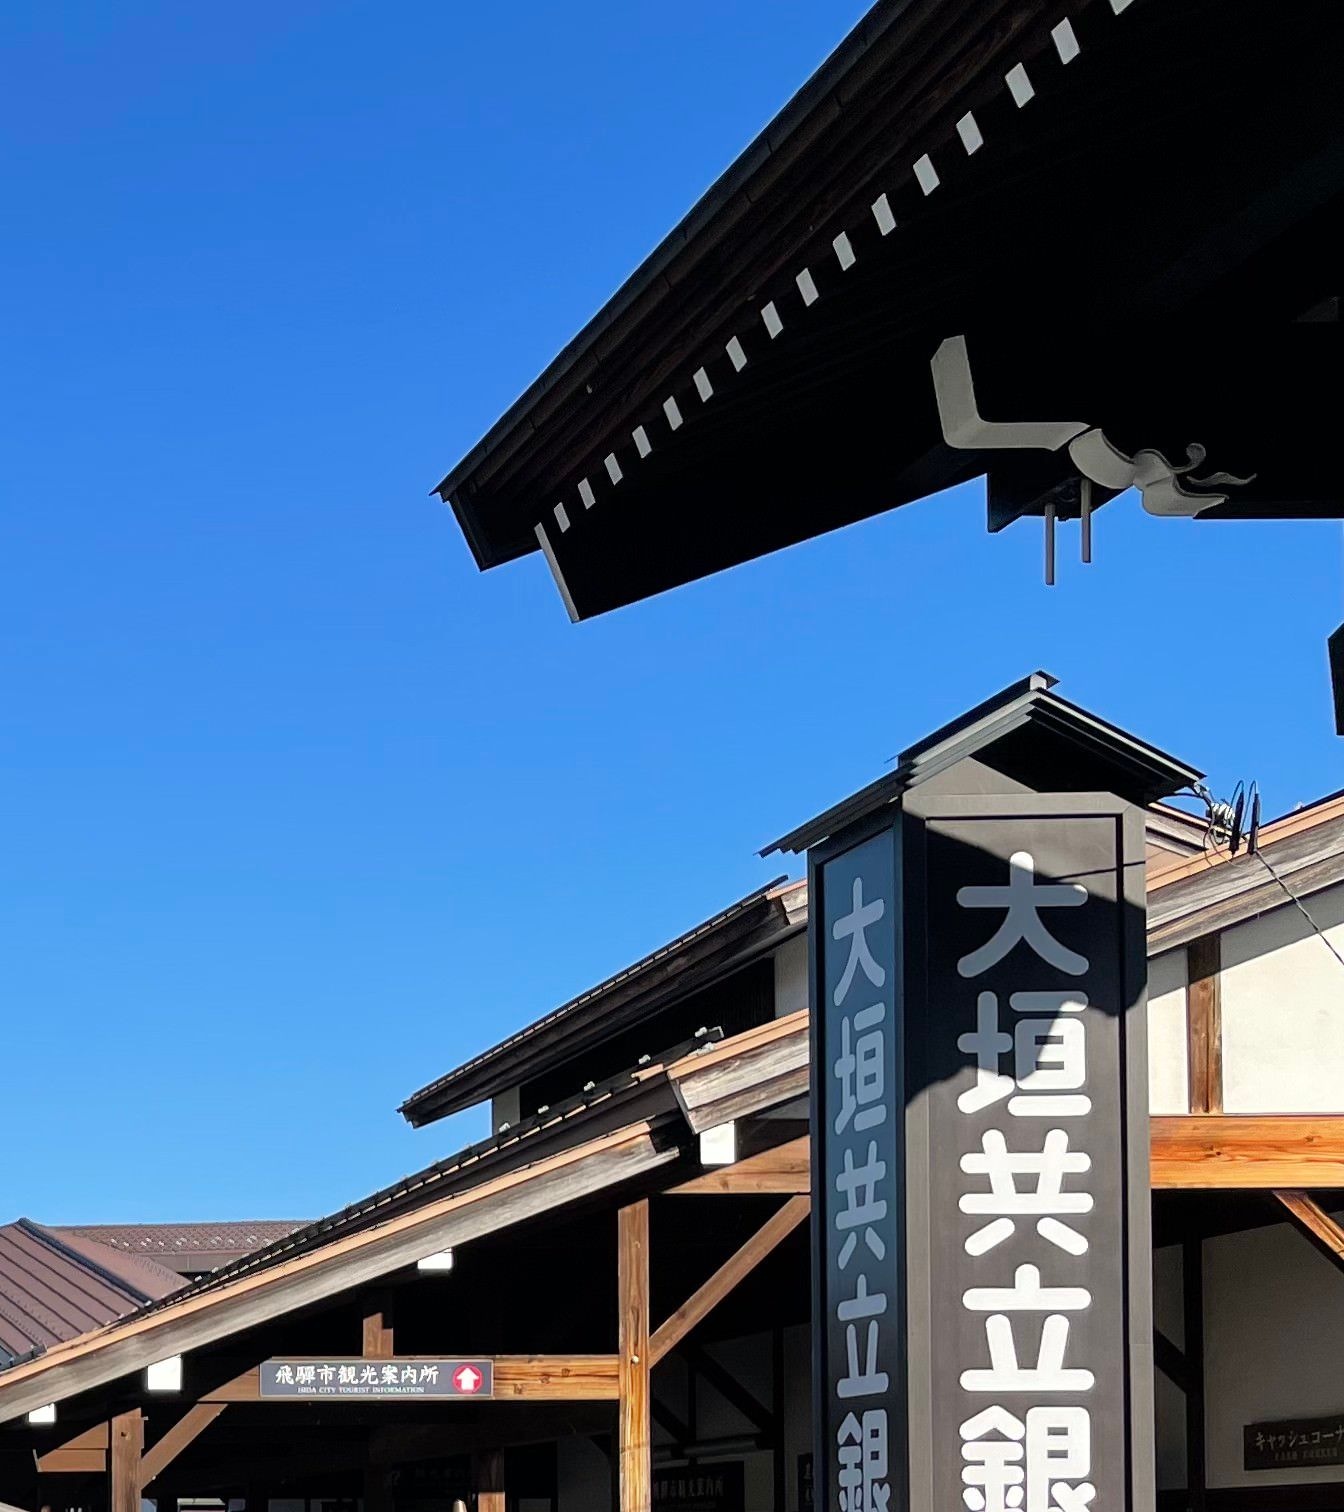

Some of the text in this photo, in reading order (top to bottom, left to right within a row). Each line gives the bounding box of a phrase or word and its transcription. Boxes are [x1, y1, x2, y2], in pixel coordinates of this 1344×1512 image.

[275, 1364, 439, 1385] 飛騨市観光案内所
[319, 1386, 336, 1394] CITY
[339, 1386, 370, 1394] TOURIST
[372, 1386, 425, 1394] INFORMATION
